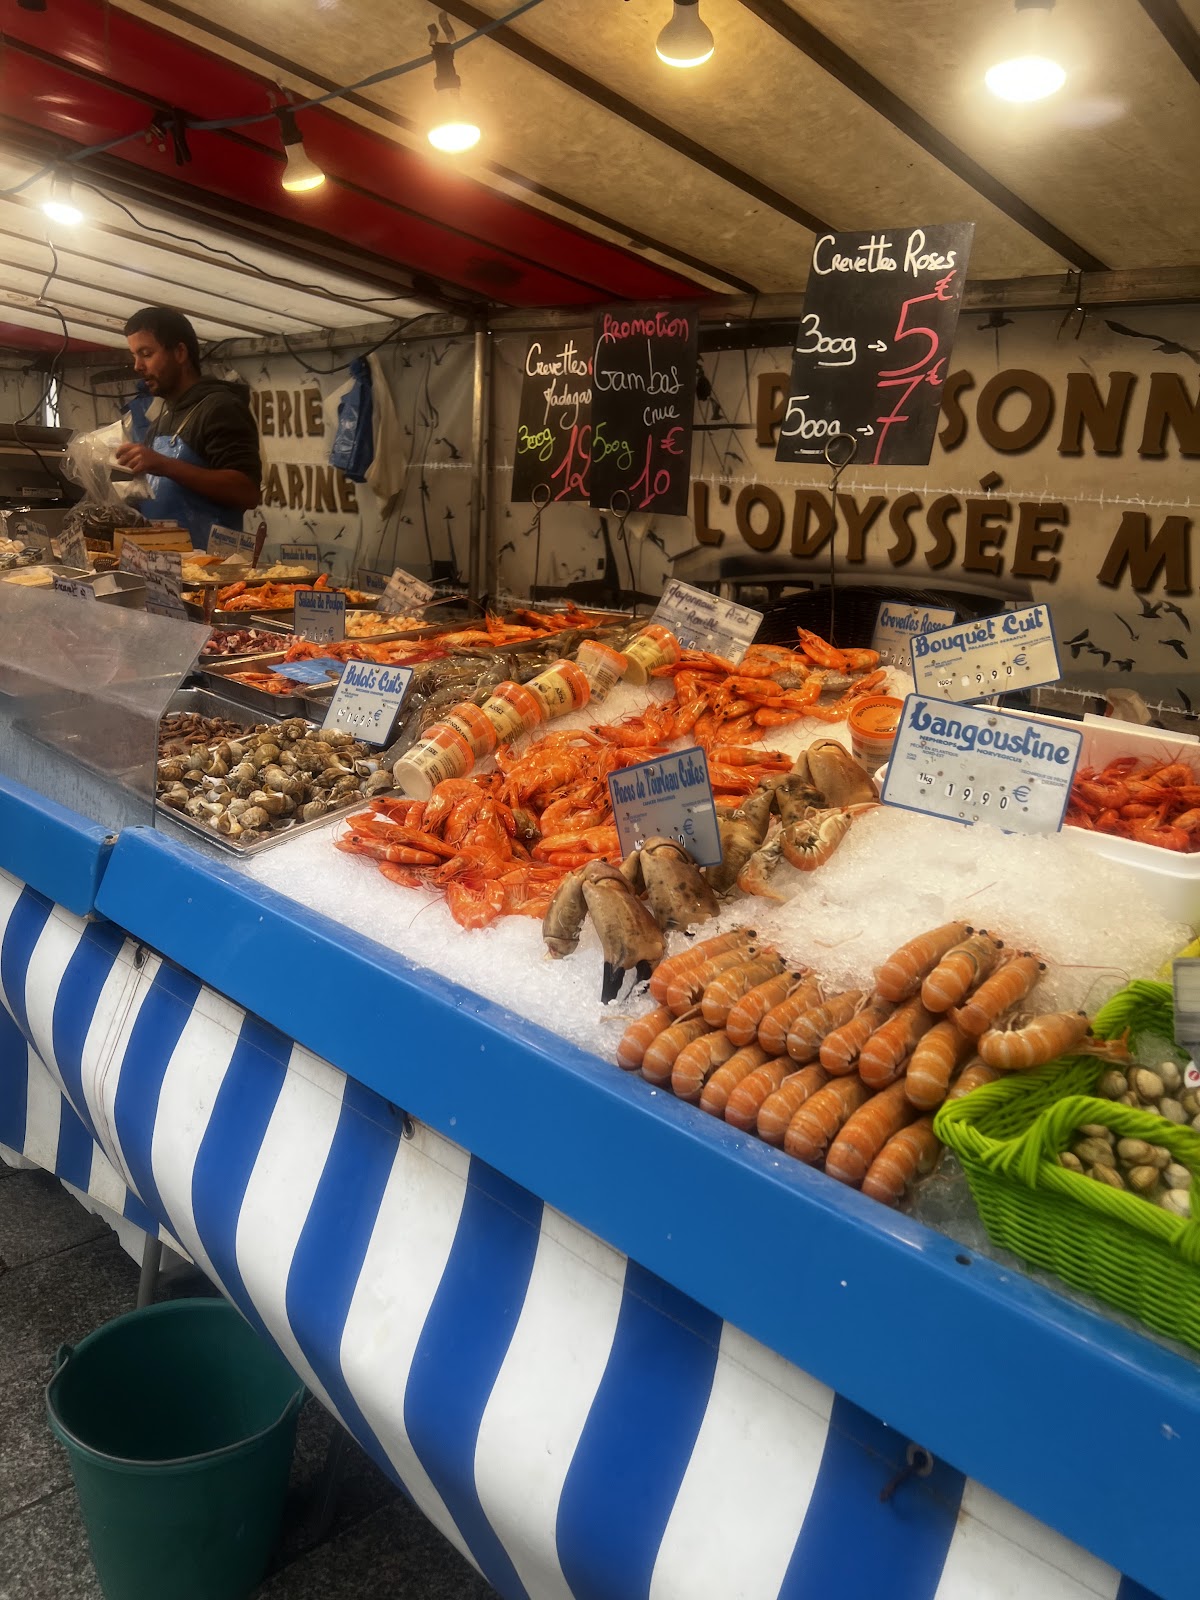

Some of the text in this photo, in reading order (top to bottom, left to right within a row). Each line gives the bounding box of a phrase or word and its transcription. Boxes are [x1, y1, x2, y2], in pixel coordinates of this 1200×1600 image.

[813, 229, 957, 278] Crevettes Roses
[796, 313, 857, 367] 300g
[525, 339, 589, 377] Crevettes
[593, 332, 685, 395] Gambas
[693, 470, 1067, 579] L'ODYSSÉE
[881, 607, 920, 631] Crevettes
[915, 607, 1044, 658] Bouquet Cuit
[1013, 653, 1028, 666] €
[374, 709, 382, 721] €
[908, 701, 1071, 765] Langoustine
[920, 735, 1022, 763] NEPHROPS NORVEGICUS
[678, 756, 705, 788] Cuites
[919, 772, 933, 785] 1kg
[1012, 785, 1031, 803] €
[683, 818, 695, 836] €
